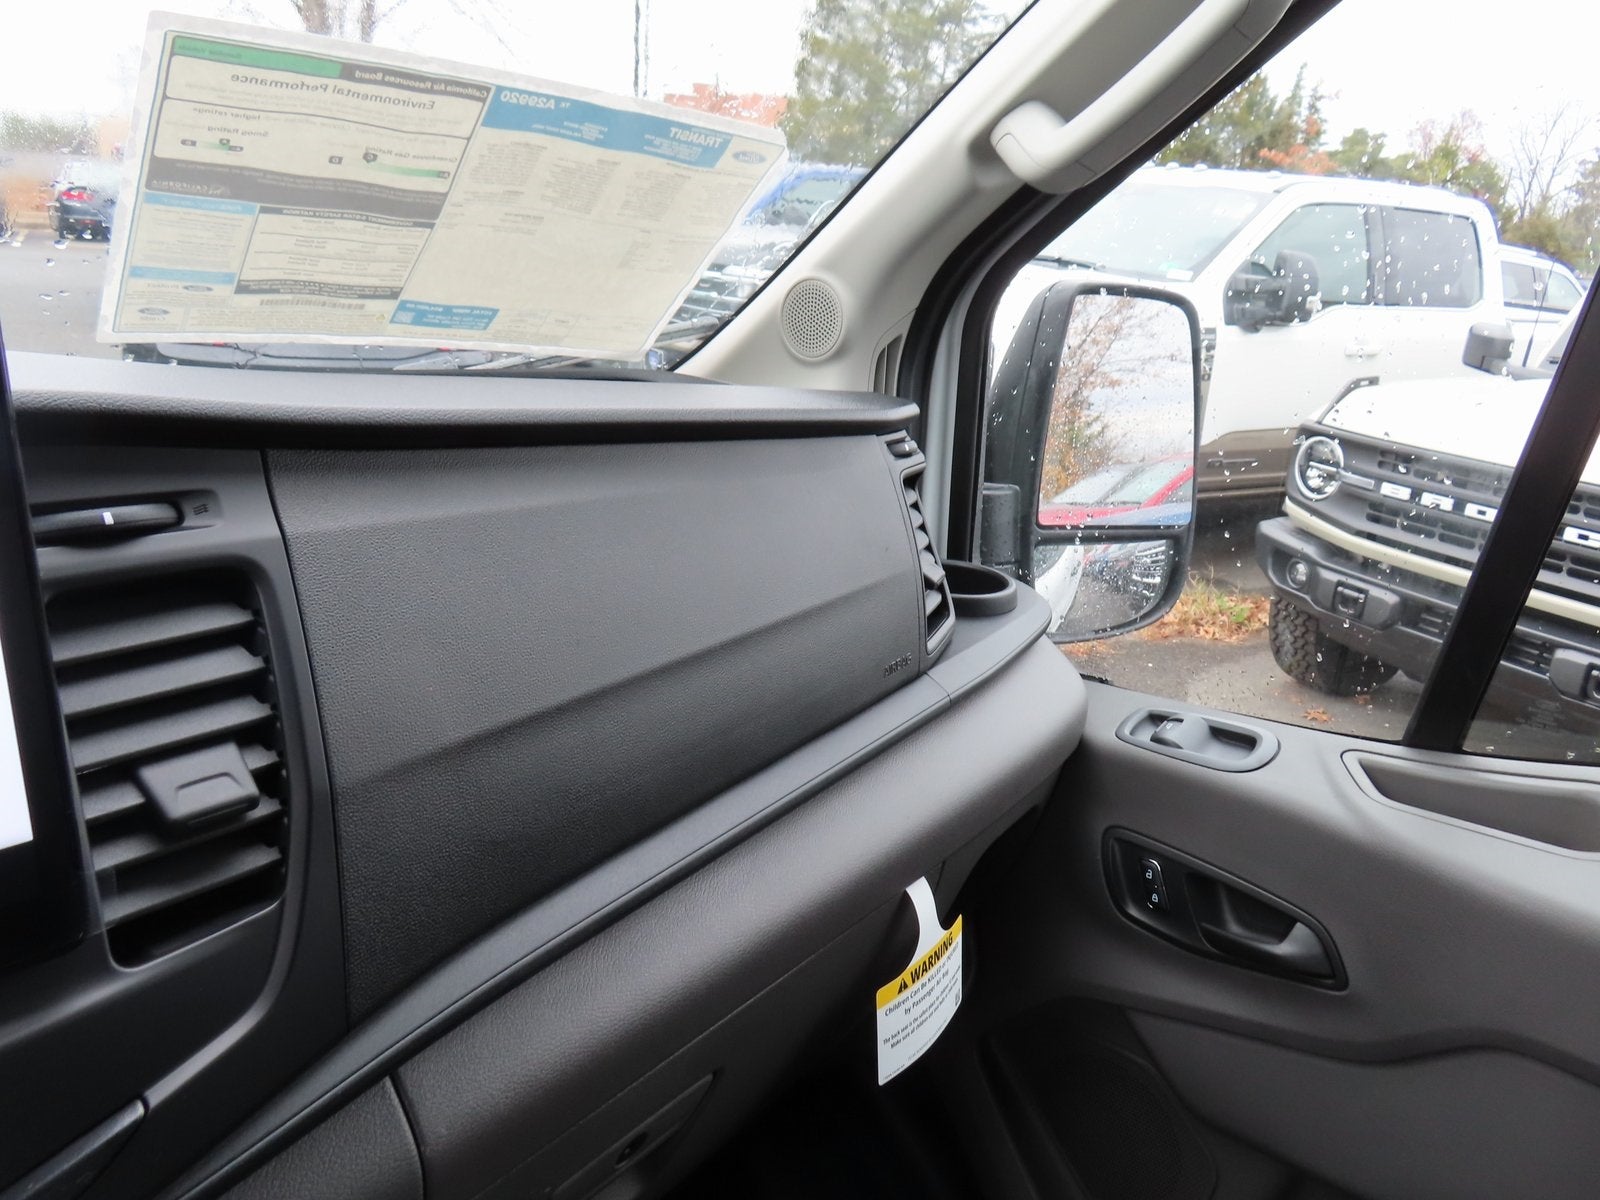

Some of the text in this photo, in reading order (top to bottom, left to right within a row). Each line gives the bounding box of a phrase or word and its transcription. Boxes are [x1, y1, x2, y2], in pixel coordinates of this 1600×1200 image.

[910, 931, 952, 985] WARNING
[885, 993, 909, 1016] Children
[910, 985, 920, 998] Can
[904, 1005, 910, 1015] by
[912, 983, 935, 1009] Passenger
[890, 1037, 900, 1048] Make
